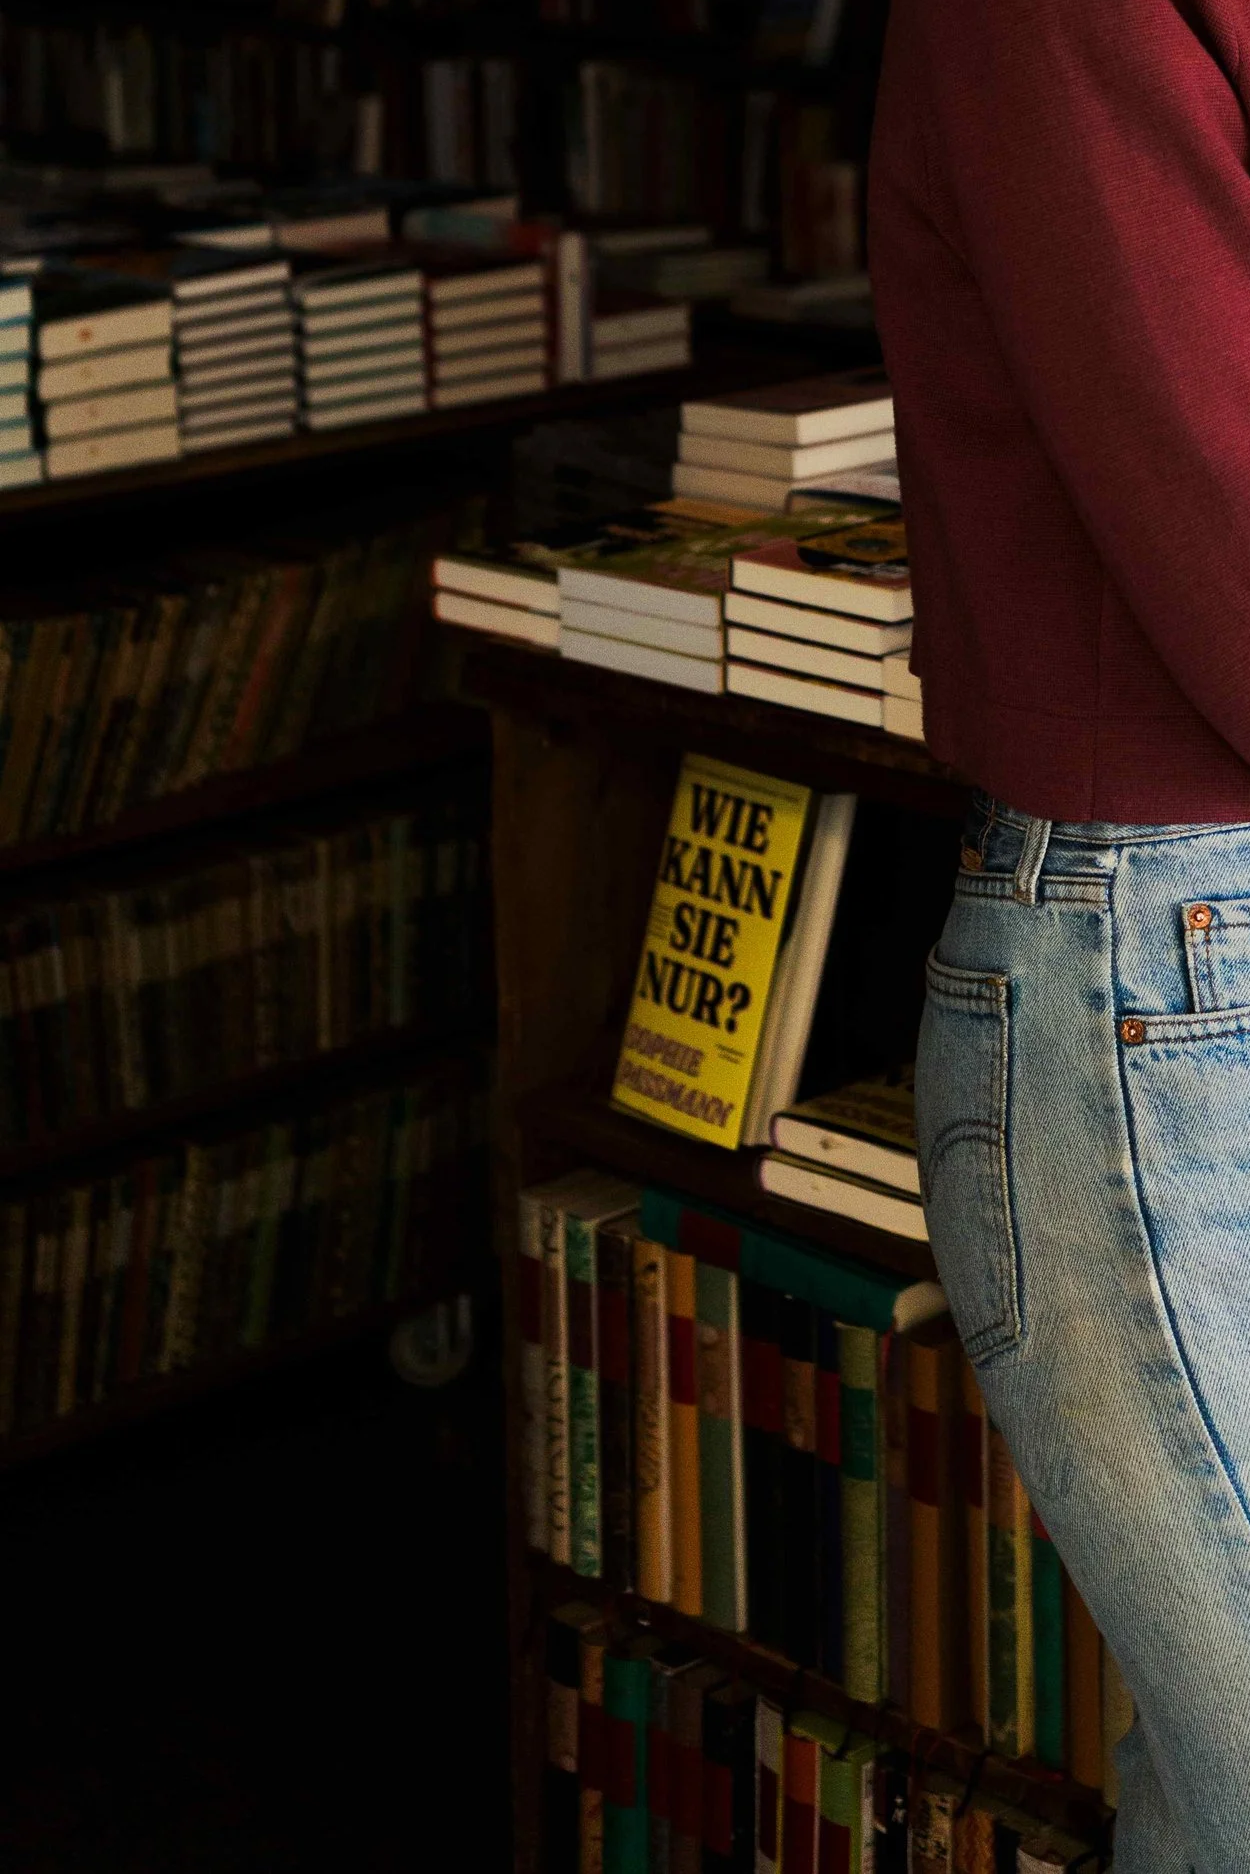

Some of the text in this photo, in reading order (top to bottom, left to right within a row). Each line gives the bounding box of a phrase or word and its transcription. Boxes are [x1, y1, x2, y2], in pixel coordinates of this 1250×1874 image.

[689, 782, 773, 857] WIE
[660, 834, 783, 922] KANN
[668, 900, 741, 969] SIE
[638, 950, 752, 1034] NUR?
